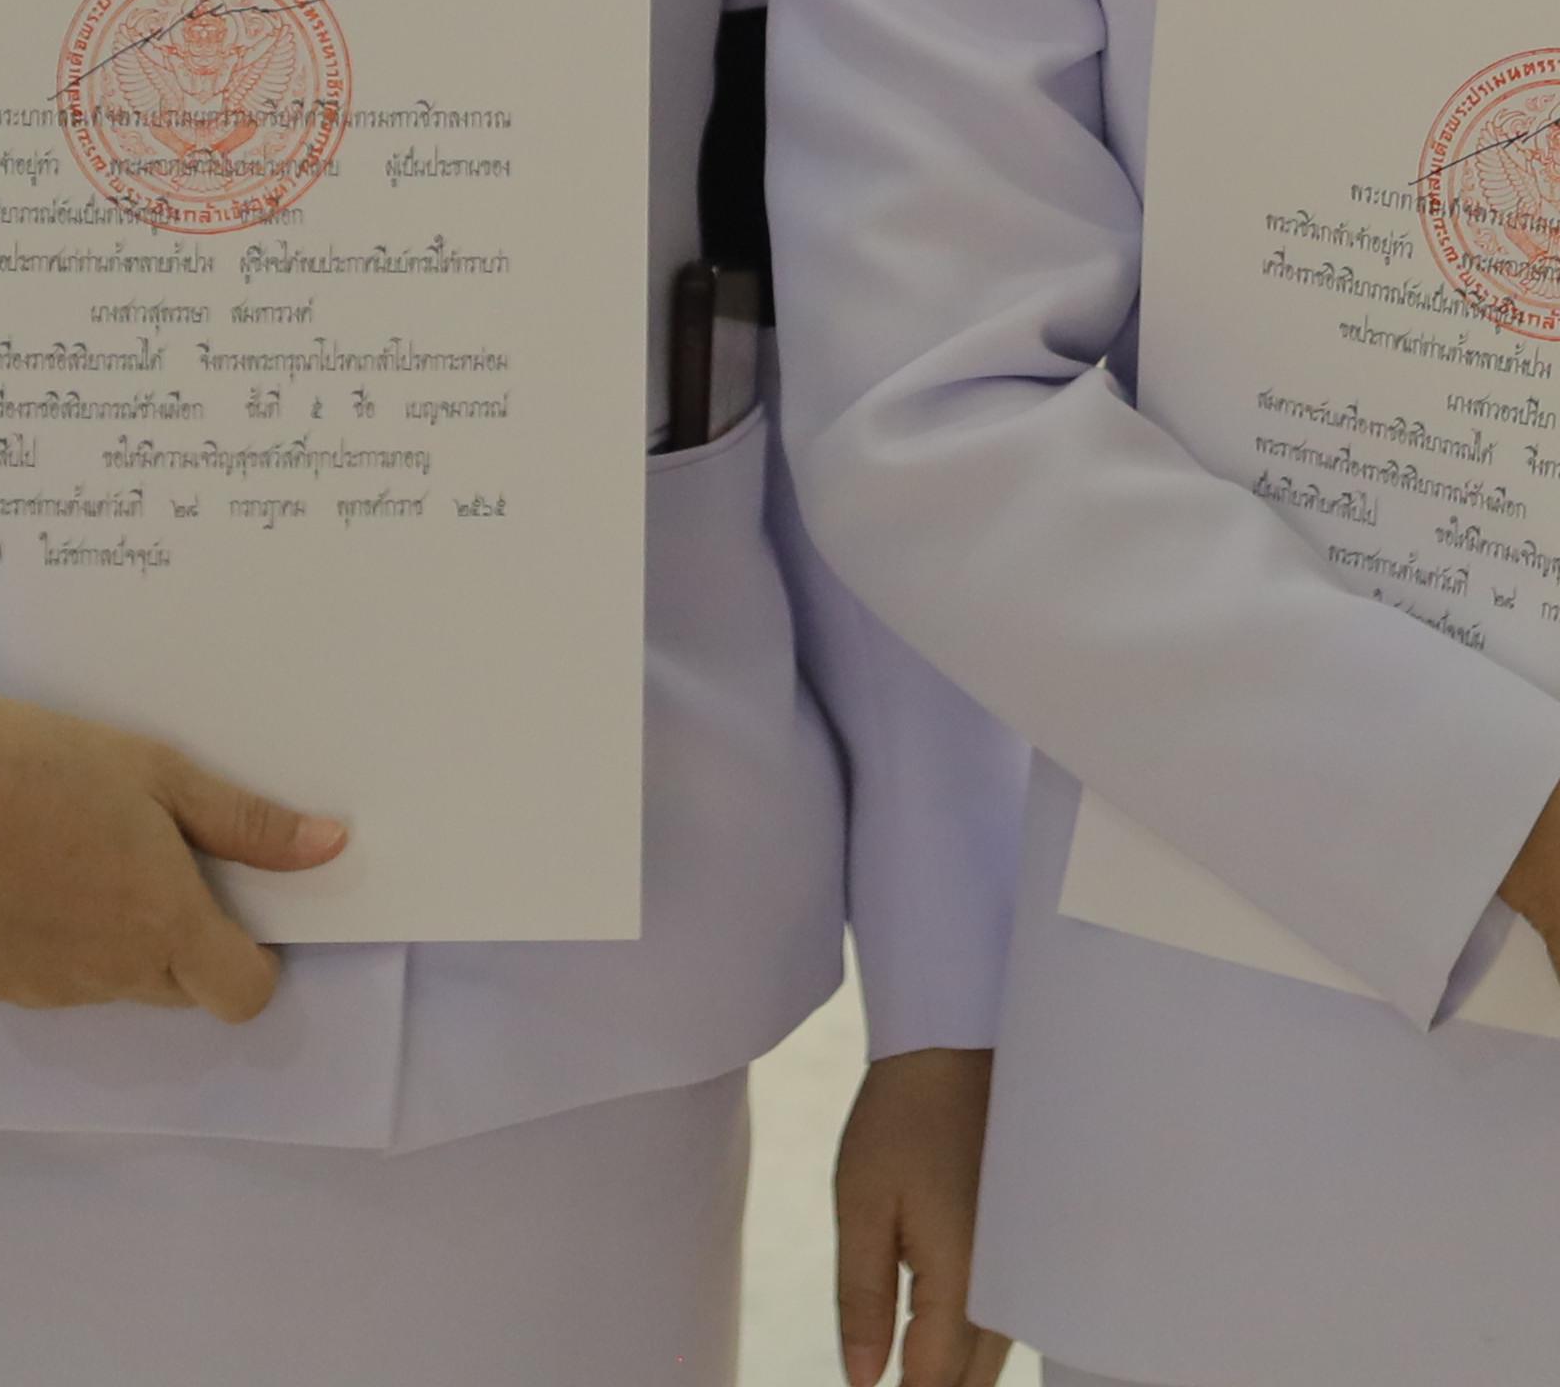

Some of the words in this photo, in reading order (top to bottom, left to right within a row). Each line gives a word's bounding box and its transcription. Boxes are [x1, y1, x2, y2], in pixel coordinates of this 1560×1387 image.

[311, 396, 323, 419] ๕
[351, 388, 375, 418] ชื่อ
[171, 496, 199, 518] ๒๘
[453, 495, 506, 517] ๒๕๖๕
[1492, 588, 1516, 609] ๒๘
